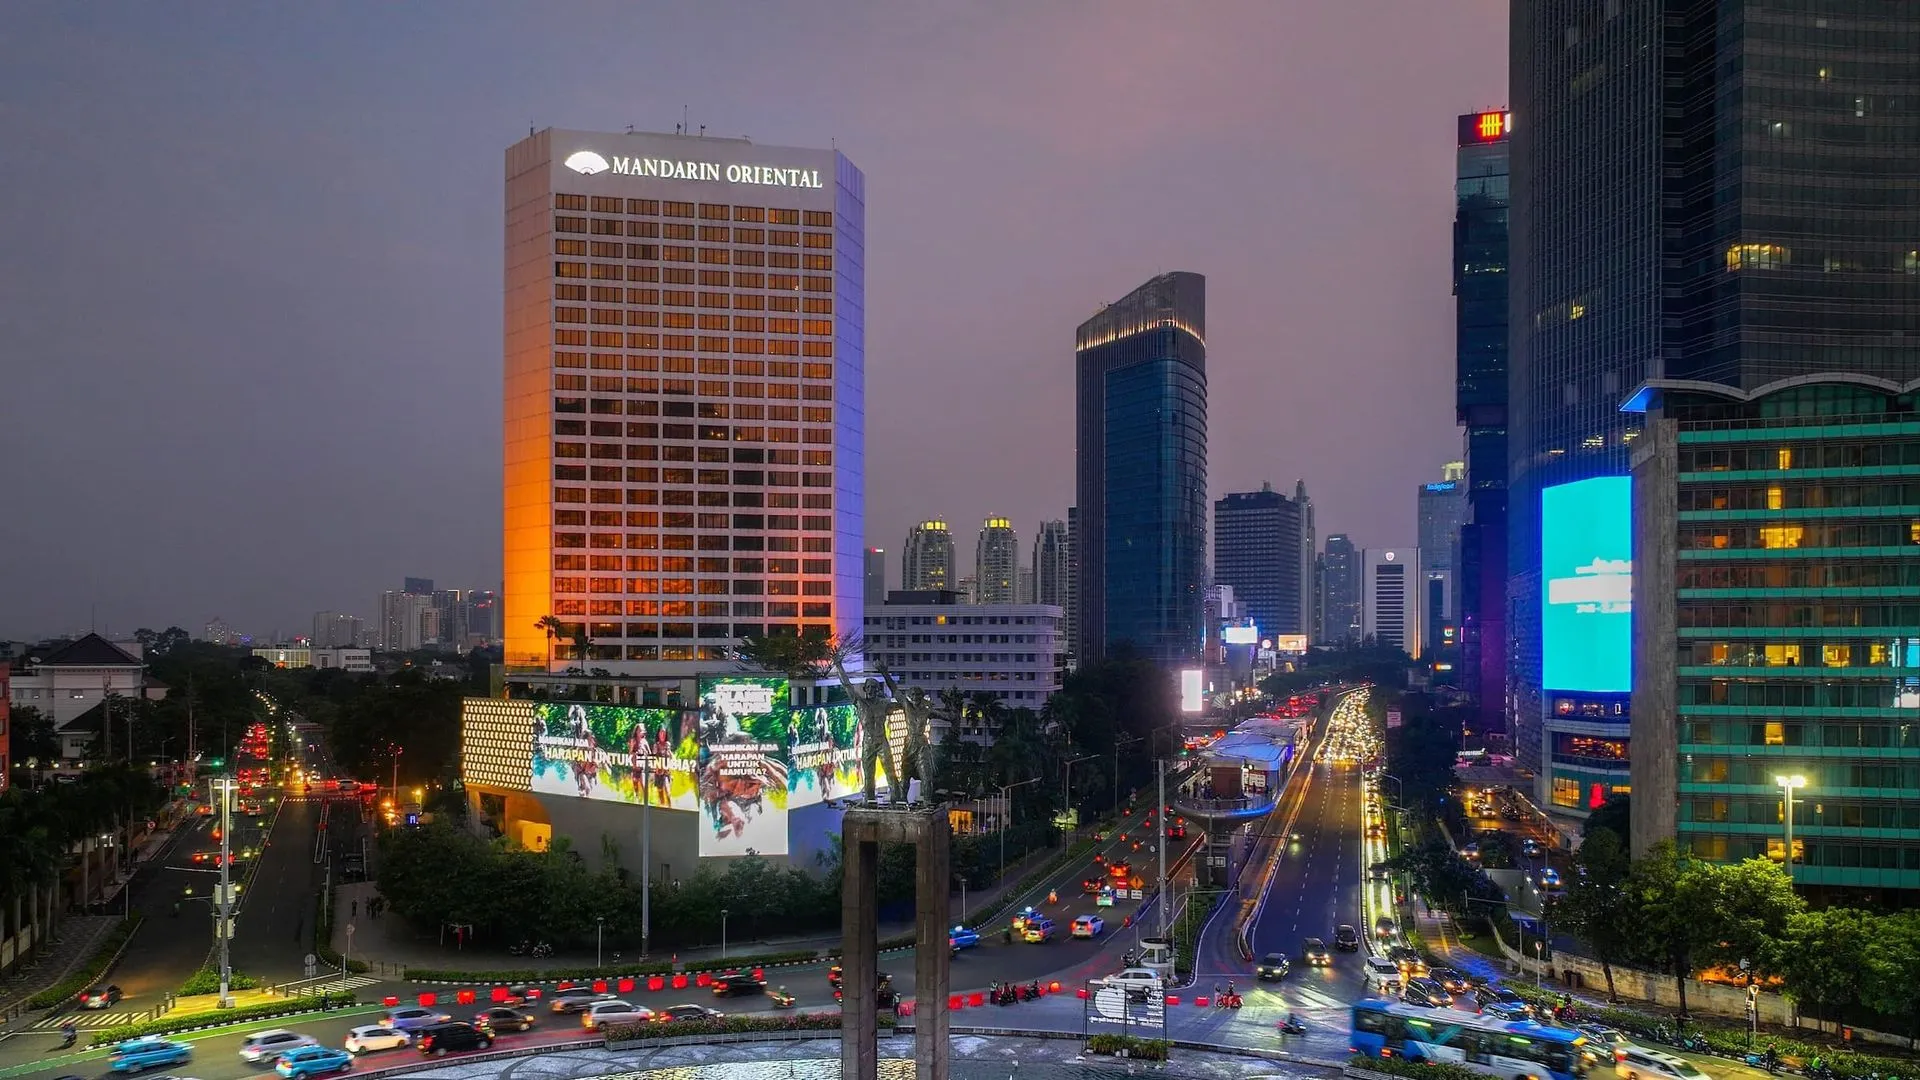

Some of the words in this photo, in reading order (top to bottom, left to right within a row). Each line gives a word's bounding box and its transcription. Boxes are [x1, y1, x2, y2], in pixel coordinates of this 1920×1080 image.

[612, 156, 720, 181] MANDARIN
[726, 164, 823, 188] ORIENTAL
[544, 746, 593, 763] HARAPAN
[595, 750, 633, 767] UNTUK
[720, 768, 767, 776] MANUSIA?
